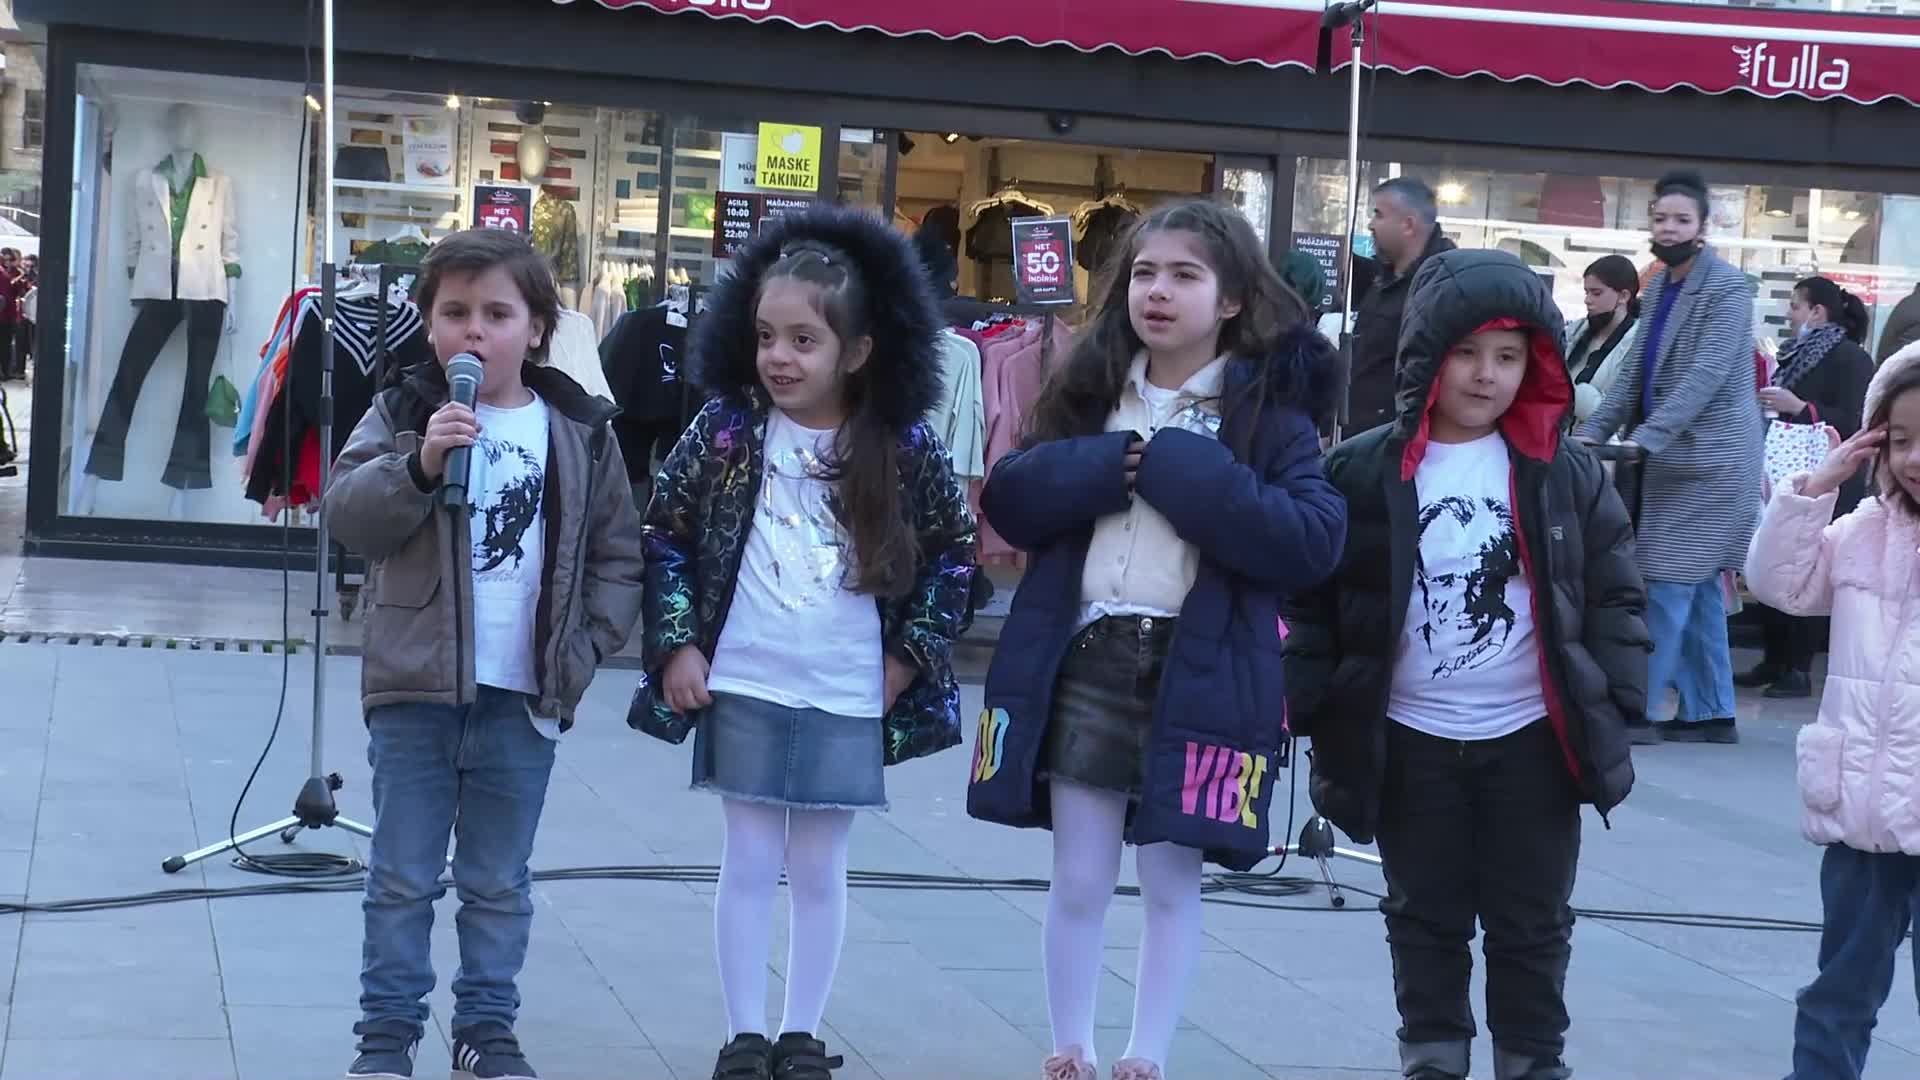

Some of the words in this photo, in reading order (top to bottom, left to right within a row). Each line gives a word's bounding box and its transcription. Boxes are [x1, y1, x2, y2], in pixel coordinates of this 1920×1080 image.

[1751, 42, 1850, 91] fulla
[738, 162, 757, 172] MÜŞ
[766, 155, 812, 172] MASKE
[761, 171, 814, 188] TAKINIZ!
[493, 208, 511, 216] NET
[726, 208, 750, 217] 10:00
[724, 229, 749, 238] 22:00
[1034, 243, 1051, 251] NET
[1328, 249, 1337, 257] VE
